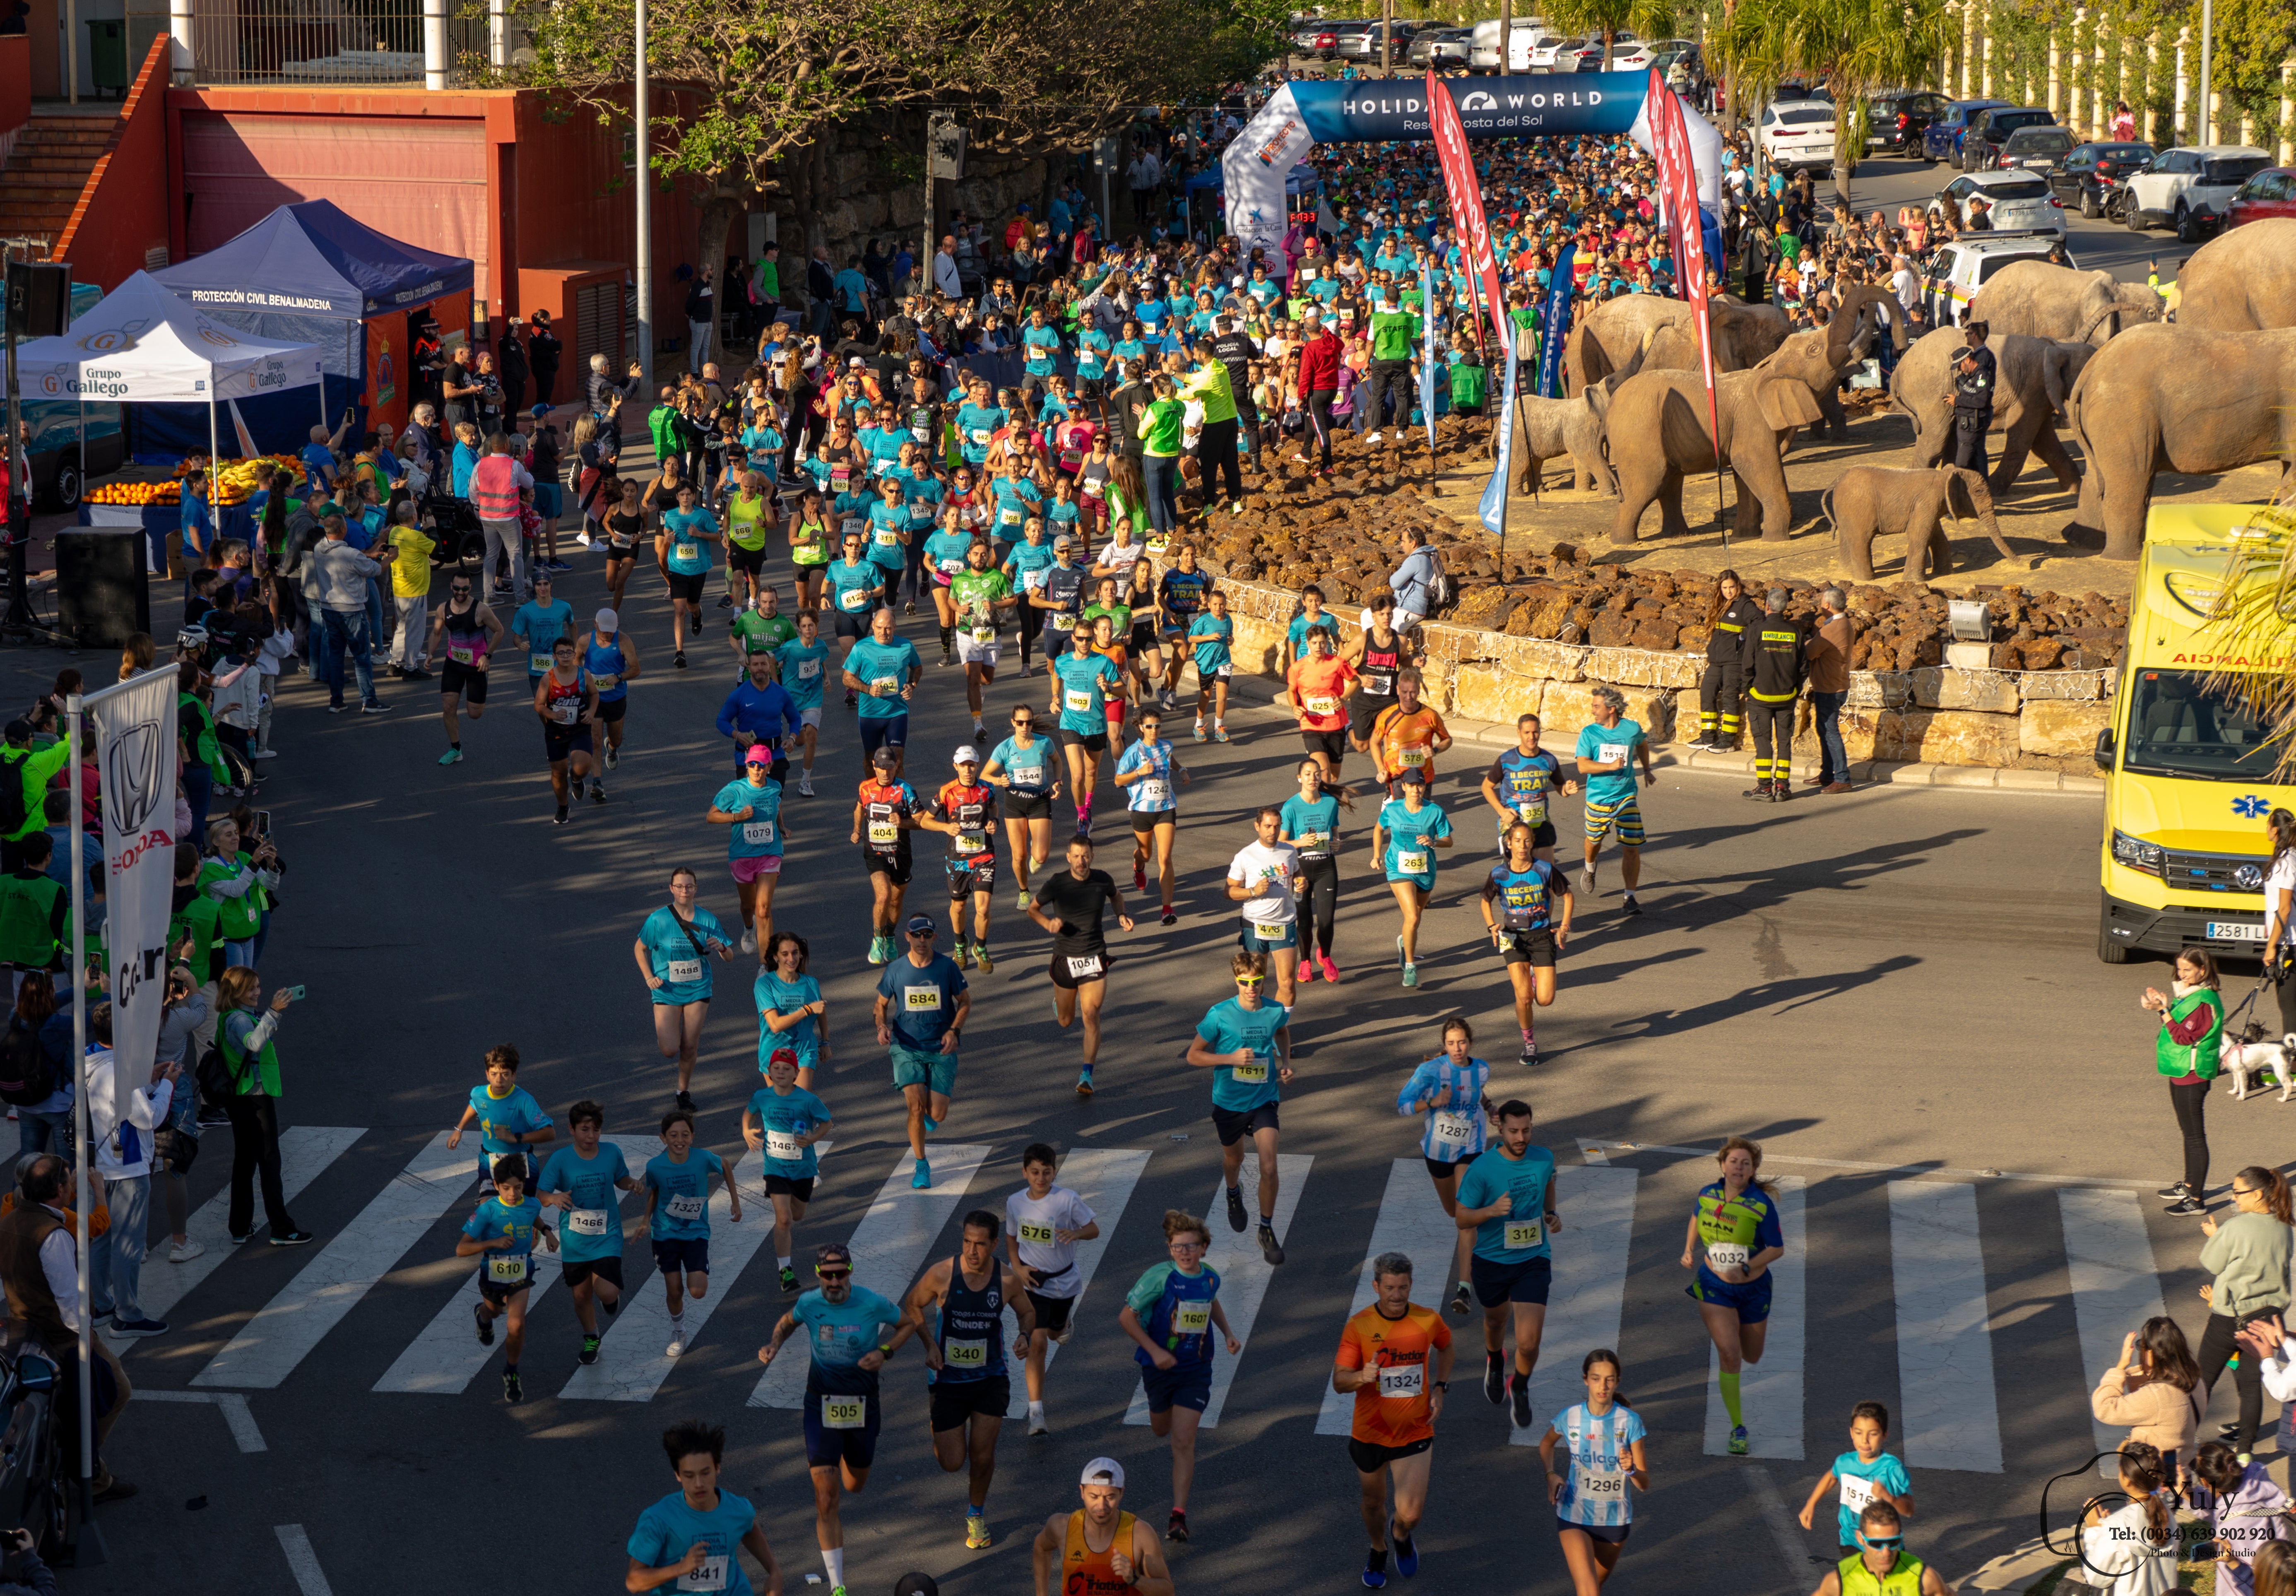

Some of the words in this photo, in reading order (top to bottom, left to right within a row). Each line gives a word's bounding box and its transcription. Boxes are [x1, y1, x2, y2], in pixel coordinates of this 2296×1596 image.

[1343, 98, 1428, 115] HOLID
[1508, 91, 1602, 109] WORLD
[1464, 116, 1493, 128] osta
[1497, 116, 1517, 127] del
[1522, 114, 1543, 126] Sol
[1265, 120, 1296, 154] PROYECTO
[193, 290, 244, 303] PROTECCIÓN
[247, 293, 267, 305] CIVIL
[269, 295, 331, 311] BENALMADENA
[1542, 290, 1564, 398] ECATHLON
[267, 361, 283, 371] Grupo
[87, 368, 121, 380] Grupo
[258, 371, 286, 388] Gallego
[45, 376, 57, 392] G
[66, 379, 128, 398] Gallego
[1166, 408, 1182, 416] STAFF
[735, 527, 750, 535] 666
[751, 631, 779, 643] mijas
[455, 651, 469, 660] 372
[804, 664, 816, 674] 935
[1069, 696, 1088, 705] 1603
[1148, 785, 1169, 794] 1242
[1526, 807, 1542, 817] 335
[746, 828, 771, 838] 1079
[874, 828, 892, 837] 404
[962, 836, 981, 845] 403
[1404, 858, 1423, 867] 263
[7, 892, 31, 902] STAFF
[2217, 924, 2250, 937] 2581
[1071, 958, 1096, 970] 1057
[674, 967, 699, 975] 1498
[909, 994, 936, 1004] 684
[1439, 1124, 1469, 1138] 1287
[1509, 1182, 1538, 1193] MARATÓN
[673, 1201, 700, 1213] 1323
[575, 1217, 603, 1226] 1466
[1702, 1220, 1733, 1233] MAN
[1021, 1225, 1051, 1239] 676
[1513, 1227, 1536, 1240] 312
[1712, 1252, 1745, 1264] 1032
[496, 1262, 521, 1274] 610
[1183, 1314, 1207, 1324] 1607
[953, 1348, 980, 1360] 340
[1390, 1349, 1425, 1362] Triatlón
[1384, 1374, 1421, 1388] 1324
[831, 1405, 858, 1418] 505
[1584, 1477, 1621, 1492] 1296
[1846, 1485, 1874, 1505] 1516
[689, 1566, 720, 1582] 841
[1086, 1578, 1129, 1591] Triatlón
